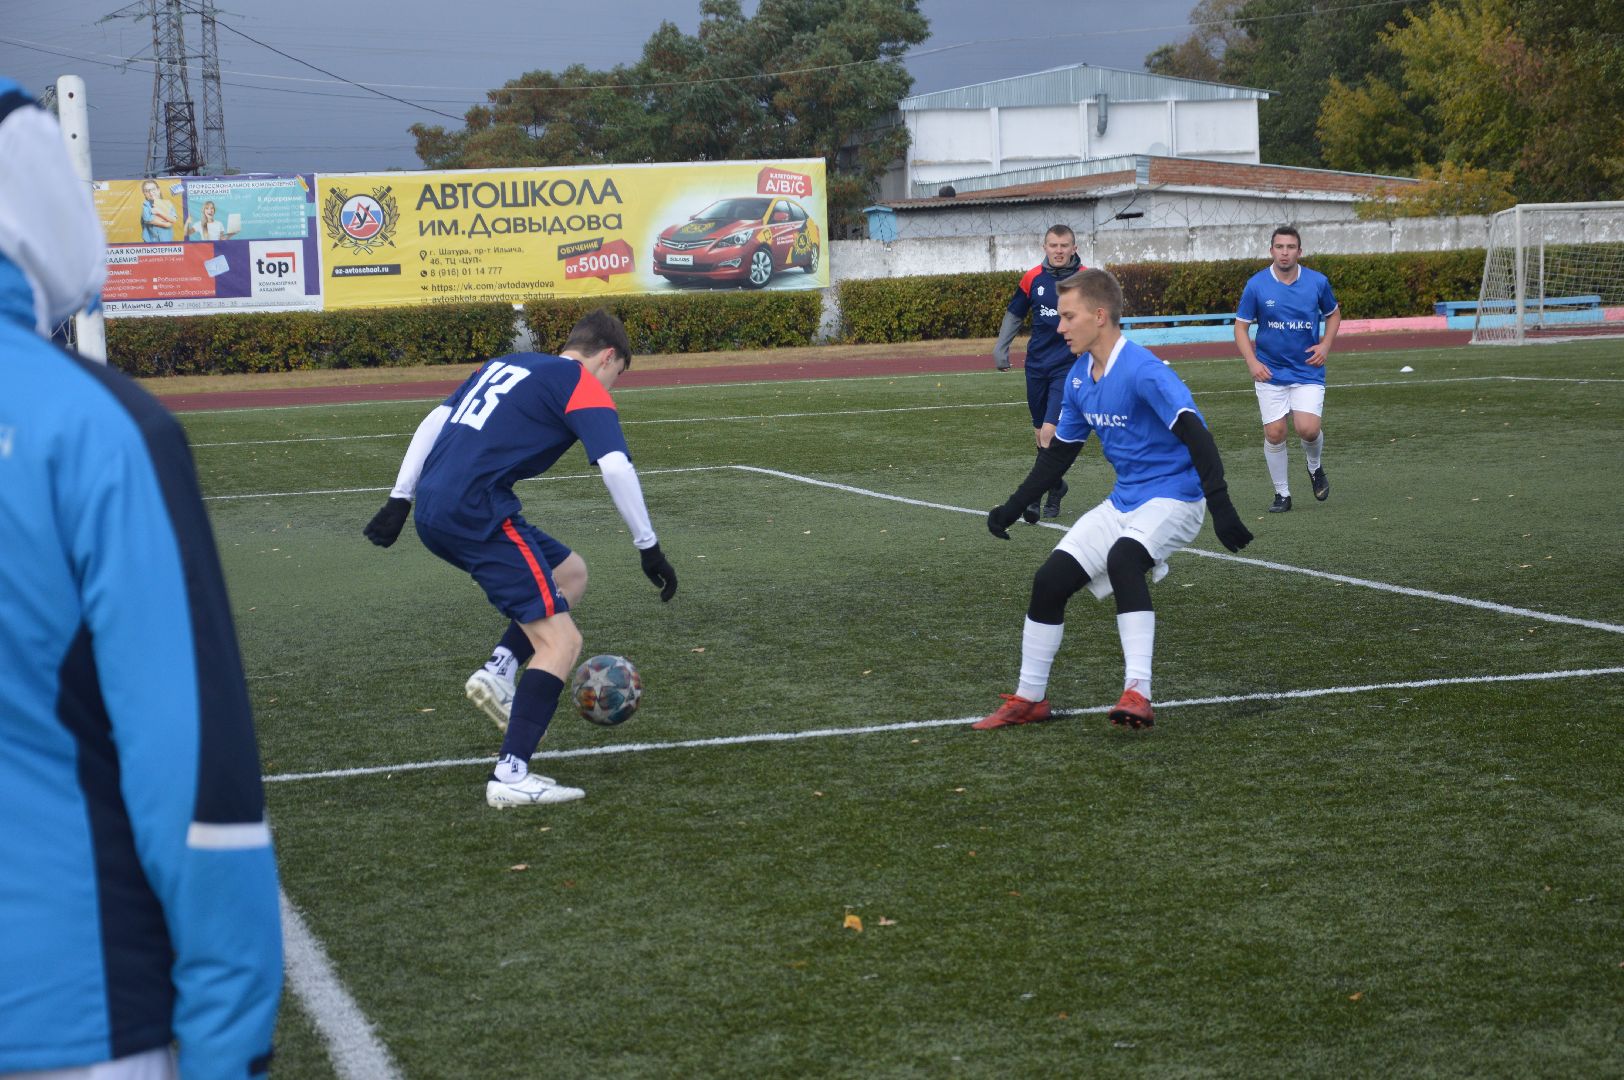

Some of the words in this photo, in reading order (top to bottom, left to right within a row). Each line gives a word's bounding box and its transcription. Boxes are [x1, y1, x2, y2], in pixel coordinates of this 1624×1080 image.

[765, 180, 805, 193] A/B/C
[416, 178, 623, 210] АВТОШКОЛА
[439, 248, 471, 257] Шатура,
[560, 241, 599, 254] ОБУЧЕНИЕ
[445, 257, 456, 265] ТЦ
[579, 253, 619, 272] 5000
[256, 258, 289, 278] top
[488, 266, 502, 275] 777
[450, 361, 532, 431] 13
